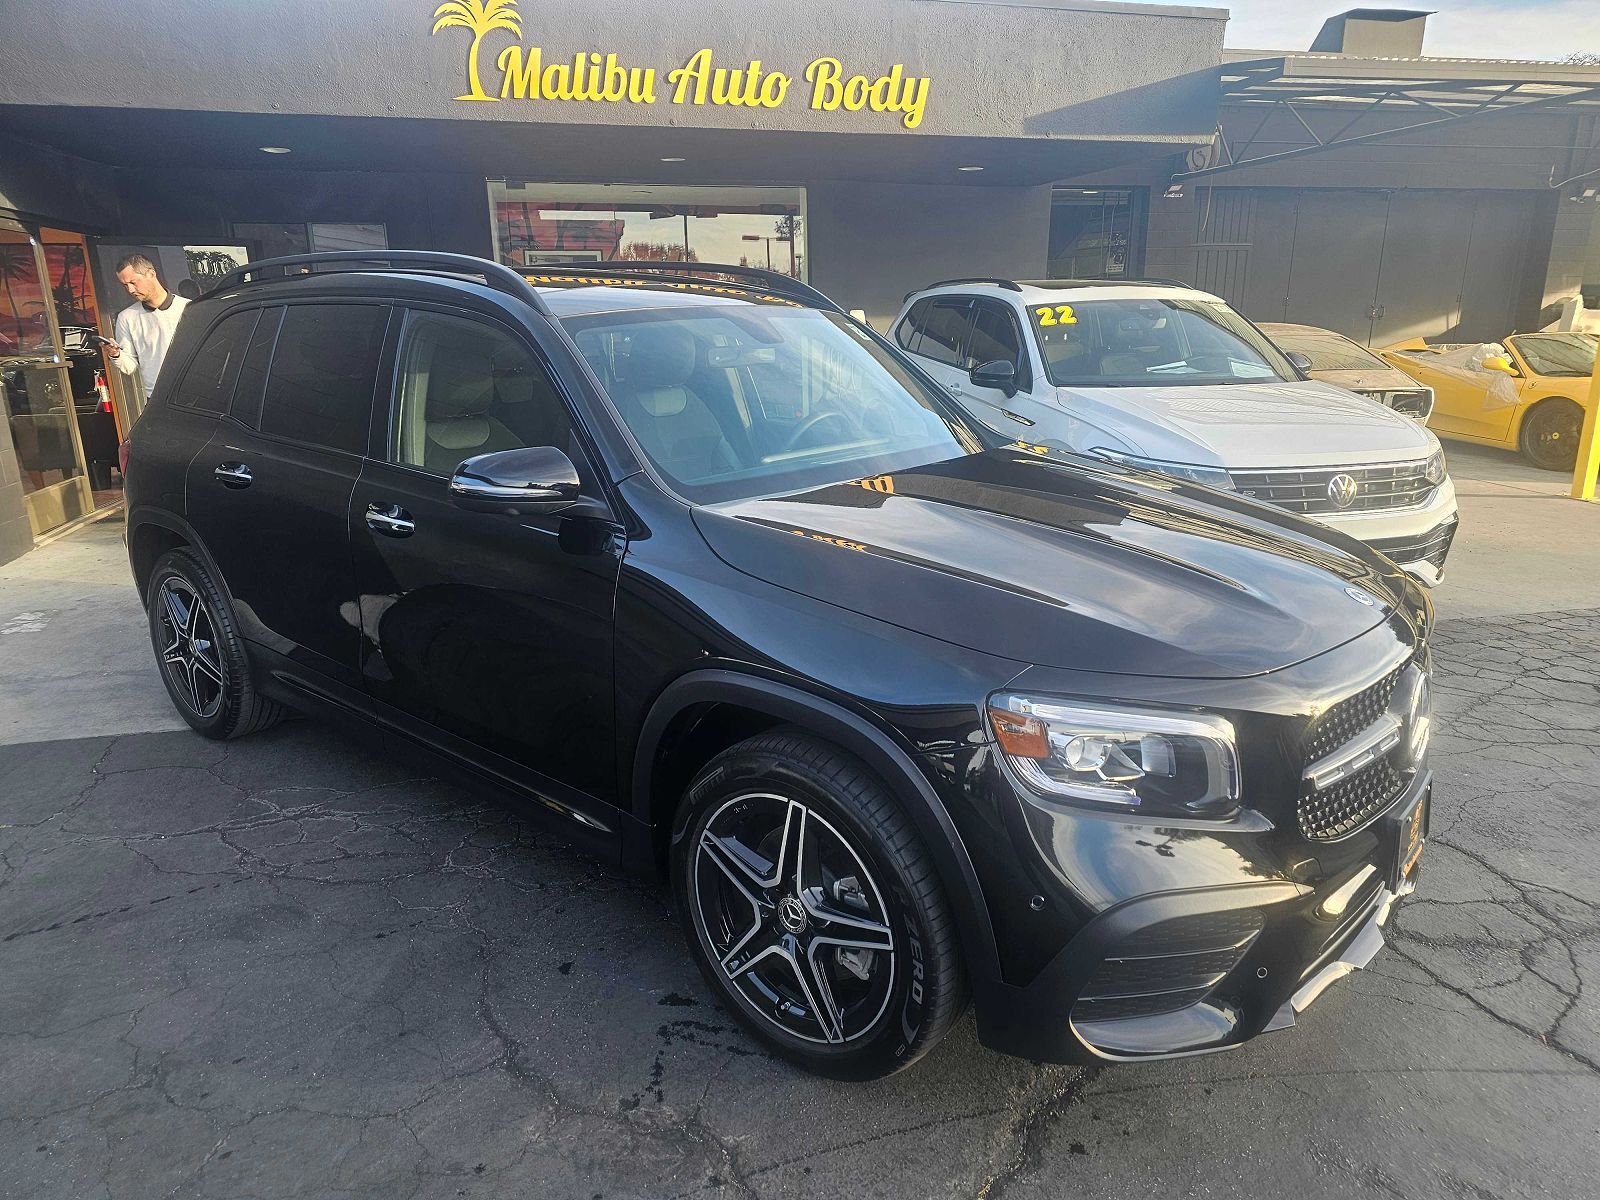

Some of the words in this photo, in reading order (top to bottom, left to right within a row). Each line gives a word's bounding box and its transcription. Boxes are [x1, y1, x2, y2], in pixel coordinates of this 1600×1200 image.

[497, 46, 656, 103] Malibu
[668, 49, 791, 107] Auto
[805, 57, 930, 128] Body
[1035, 305, 1078, 326] 22
[903, 913, 924, 1005] ZERO
